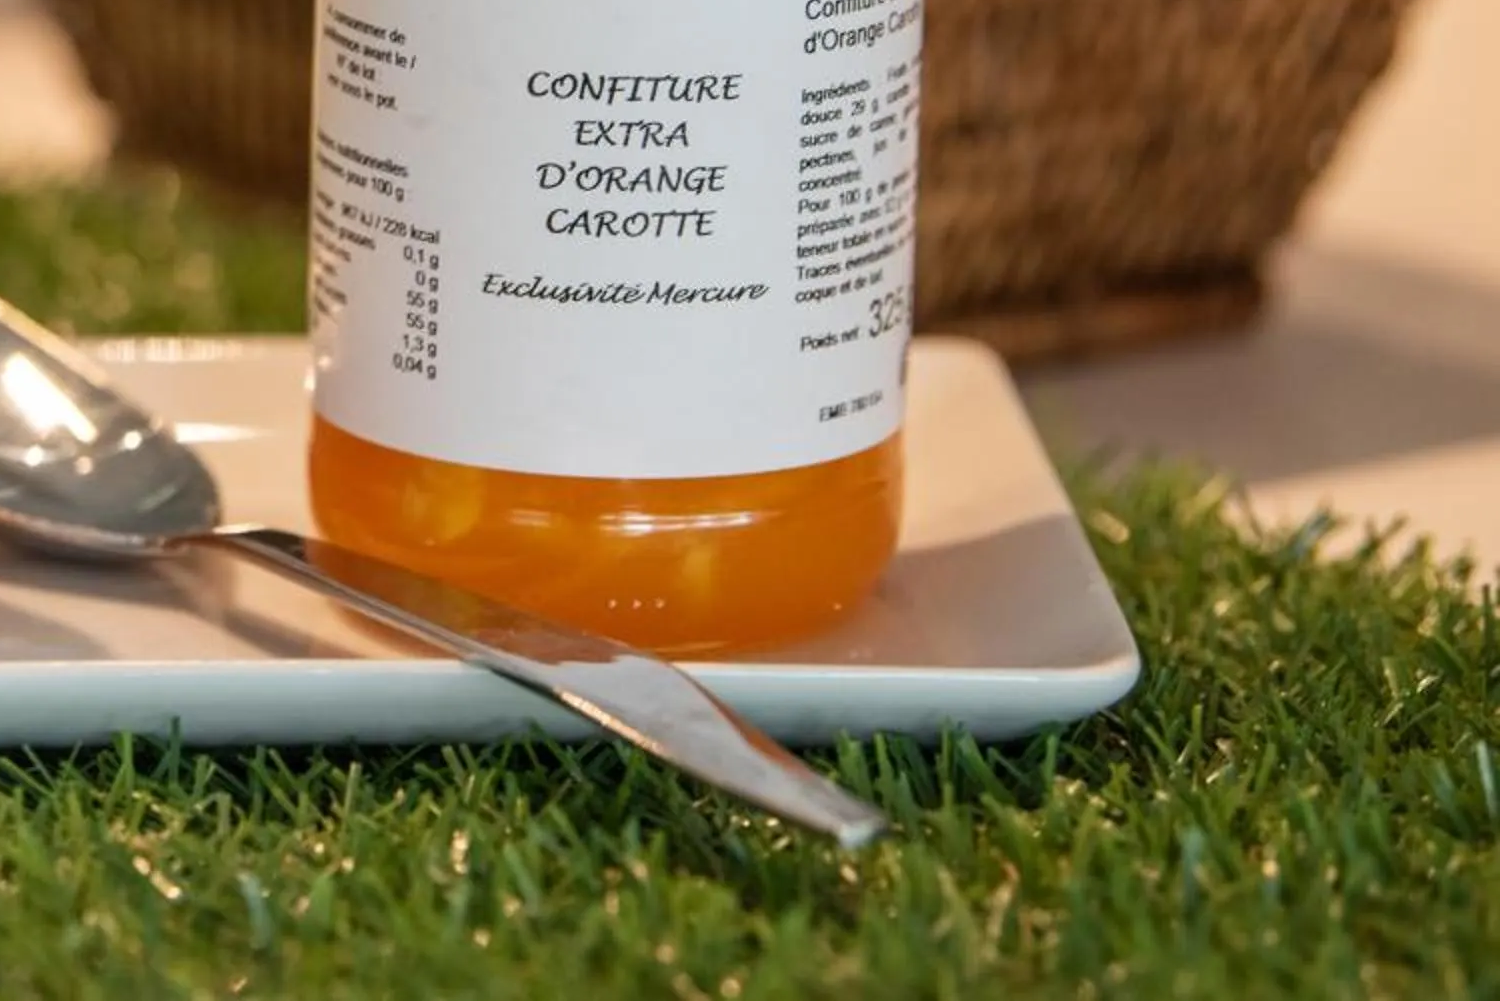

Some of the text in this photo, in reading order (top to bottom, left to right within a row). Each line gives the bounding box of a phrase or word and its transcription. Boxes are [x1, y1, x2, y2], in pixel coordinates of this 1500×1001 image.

[389, 28, 407, 46] de
[804, 20, 884, 54] d'Orange
[395, 51, 408, 69] le
[526, 71, 743, 105] CONFITURE
[800, 108, 842, 126] douce
[573, 120, 690, 149] EXTRA
[800, 130, 838, 149] sucre
[847, 123, 862, 139] de
[371, 176, 393, 197] 100
[536, 160, 728, 195] D'ORANGE
[798, 197, 831, 214] Pour
[839, 187, 862, 206] 100
[545, 208, 717, 238] CAROTTE
[410, 224, 440, 245] kcal
[796, 238, 840, 259] teneur
[429, 254, 439, 271] g
[796, 263, 842, 281] Traces
[429, 277, 439, 293] g
[481, 272, 770, 306] Exclusivité Mercure
[795, 283, 838, 304] coque
[428, 299, 438, 315] g
[428, 320, 438, 336] g
[428, 343, 438, 359] g
[800, 334, 840, 352] Poids
[427, 364, 437, 381] g
